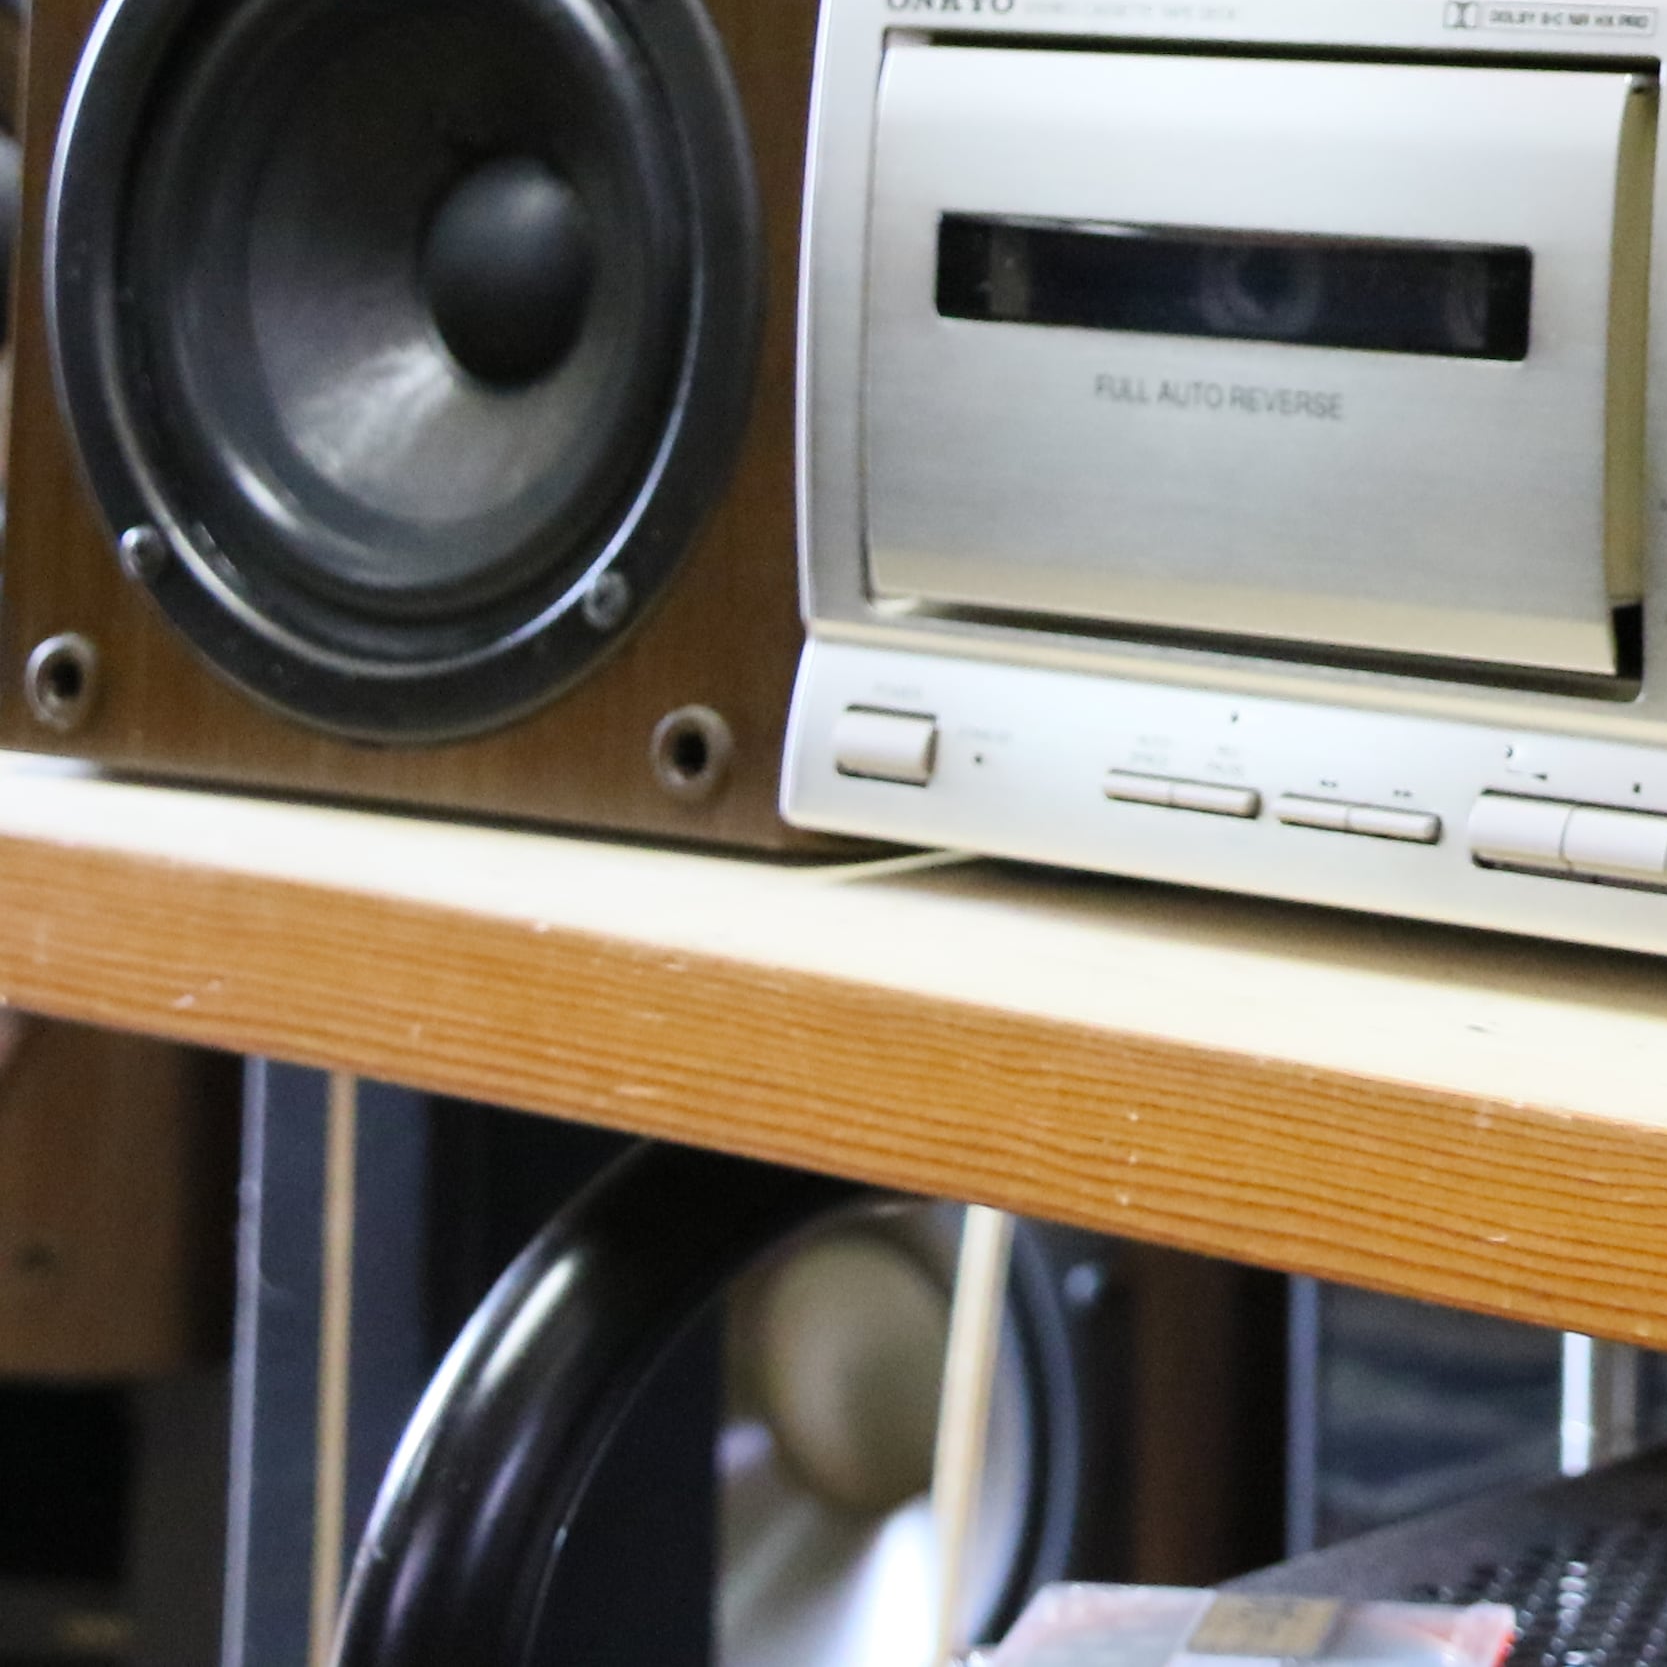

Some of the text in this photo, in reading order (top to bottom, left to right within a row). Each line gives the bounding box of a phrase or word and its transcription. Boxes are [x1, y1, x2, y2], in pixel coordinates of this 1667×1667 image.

[1094, 372, 1345, 422] FULL AUTO REVERSE
